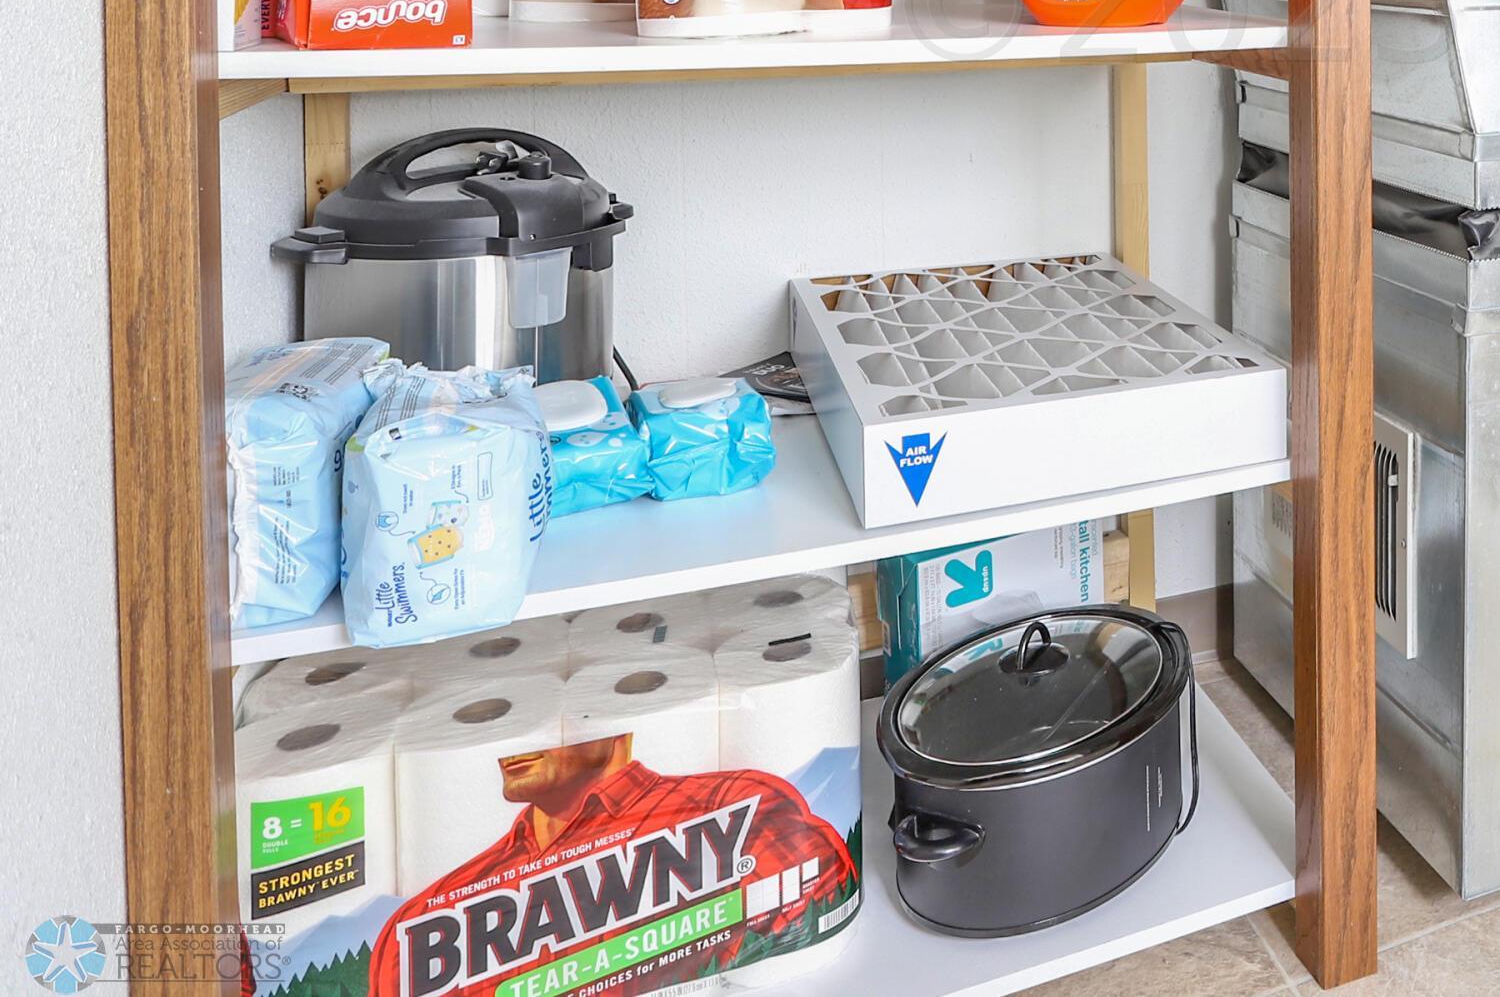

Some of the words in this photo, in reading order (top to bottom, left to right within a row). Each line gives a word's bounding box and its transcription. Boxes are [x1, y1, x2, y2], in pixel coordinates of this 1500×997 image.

[900, 454, 934, 468] FLOW
[905, 445, 927, 457] AIR
[528, 472, 546, 542] Little
[1079, 520, 1090, 543] tall
[1079, 546, 1091, 603] kitchen
[375, 581, 396, 611] Little
[262, 816, 282, 839] 8
[308, 795, 353, 831] 16
[262, 839, 289, 848] DOUBLE
[258, 854, 355, 894] STRONGEST
[426, 895, 446, 908] THE
[448, 875, 501, 901] STRENGTH
[503, 869, 516, 880] TO
[518, 860, 543, 875] TAKE
[544, 855, 559, 866] ON
[560, 843, 592, 861] TOUGH
[594, 828, 633, 848] MESSES
[258, 883, 316, 909] BRAWNY
[321, 870, 356, 890] EVER
[508, 900, 729, 997] TEAR-A-SQUARE
[579, 969, 633, 997] CHOICES
[636, 963, 654, 977] for
[658, 948, 692, 967] MORE
[696, 929, 732, 952] TASKS
